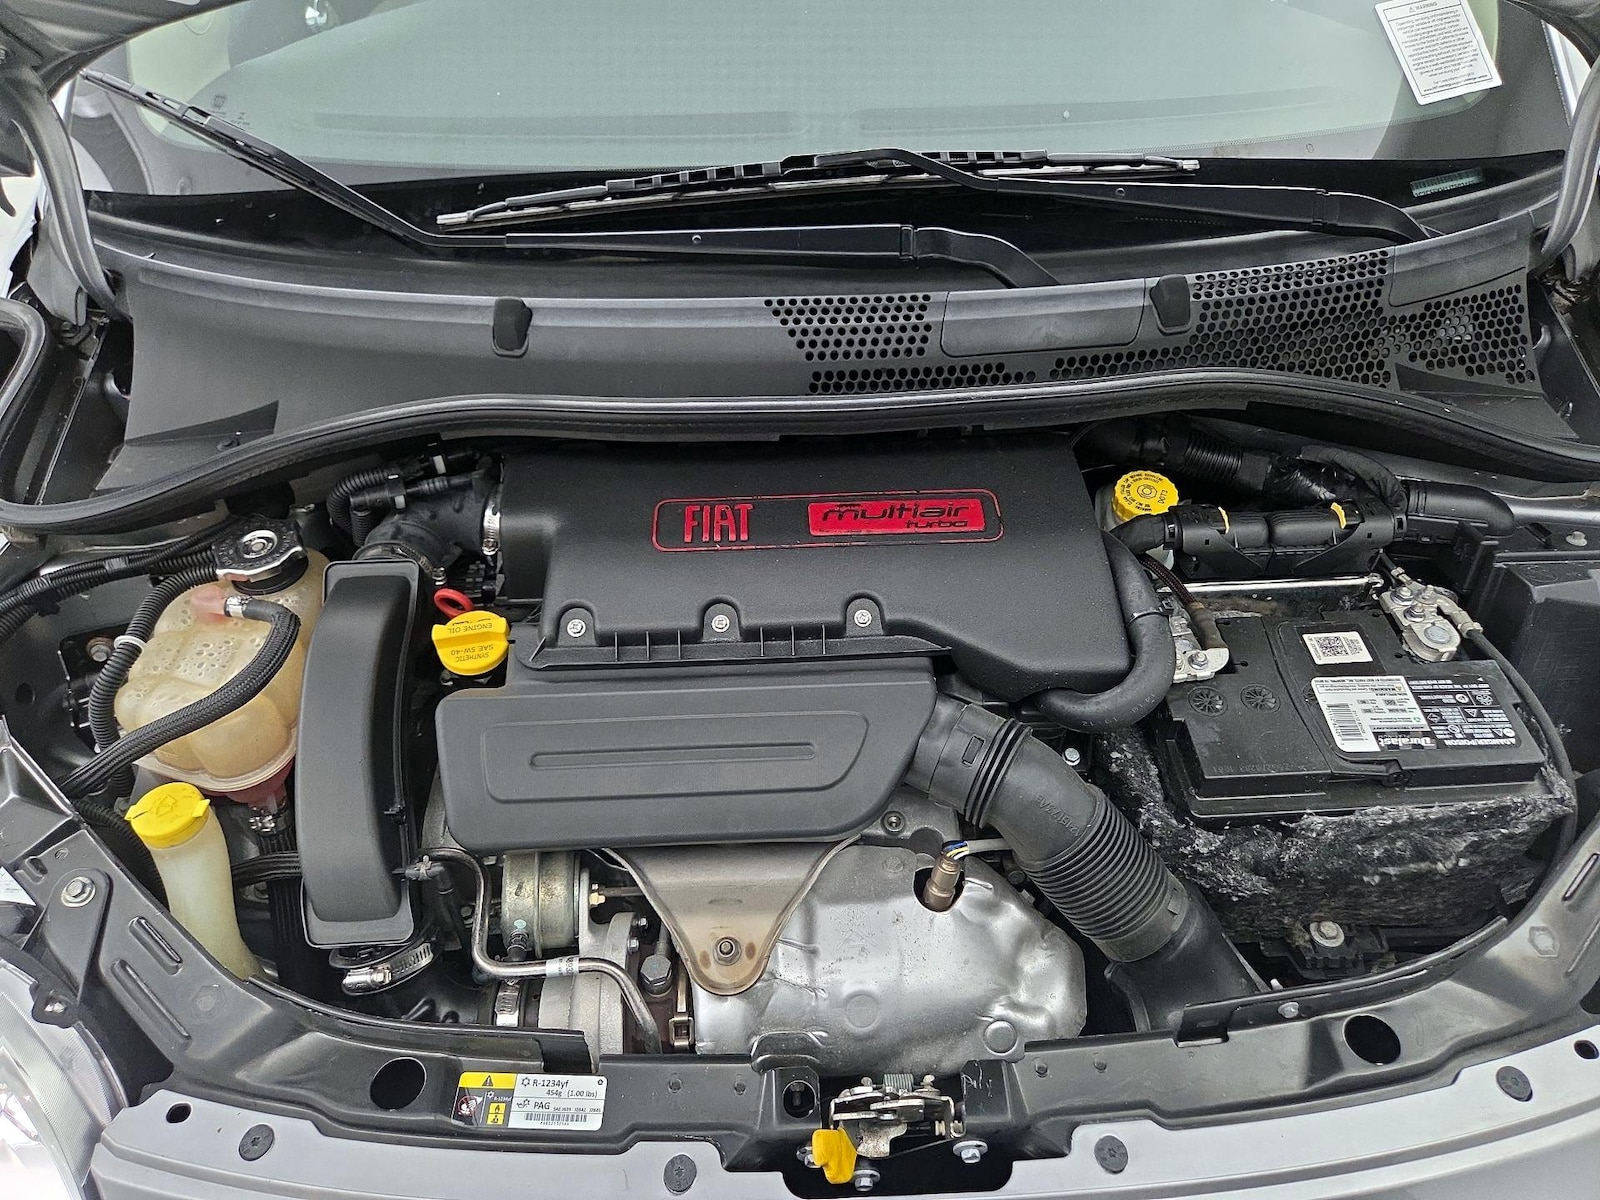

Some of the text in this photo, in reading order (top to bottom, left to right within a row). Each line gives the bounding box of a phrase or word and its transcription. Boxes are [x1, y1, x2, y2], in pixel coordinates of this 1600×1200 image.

[822, 500, 970, 522] multiair
[684, 503, 755, 543] FIAT
[905, 518, 968, 529] turbo
[447, 622, 492, 634] ENGINE OIL
[450, 644, 494, 656] SAE 5W-40
[454, 652, 490, 662] SYNTHETIC
[1378, 736, 1436, 748] Duralast
[532, 1078, 569, 1090] R-1234yf
[546, 1089, 563, 1098] 454g
[567, 1089, 584, 1098] (1.00
[533, 1101, 550, 1110] PAG
